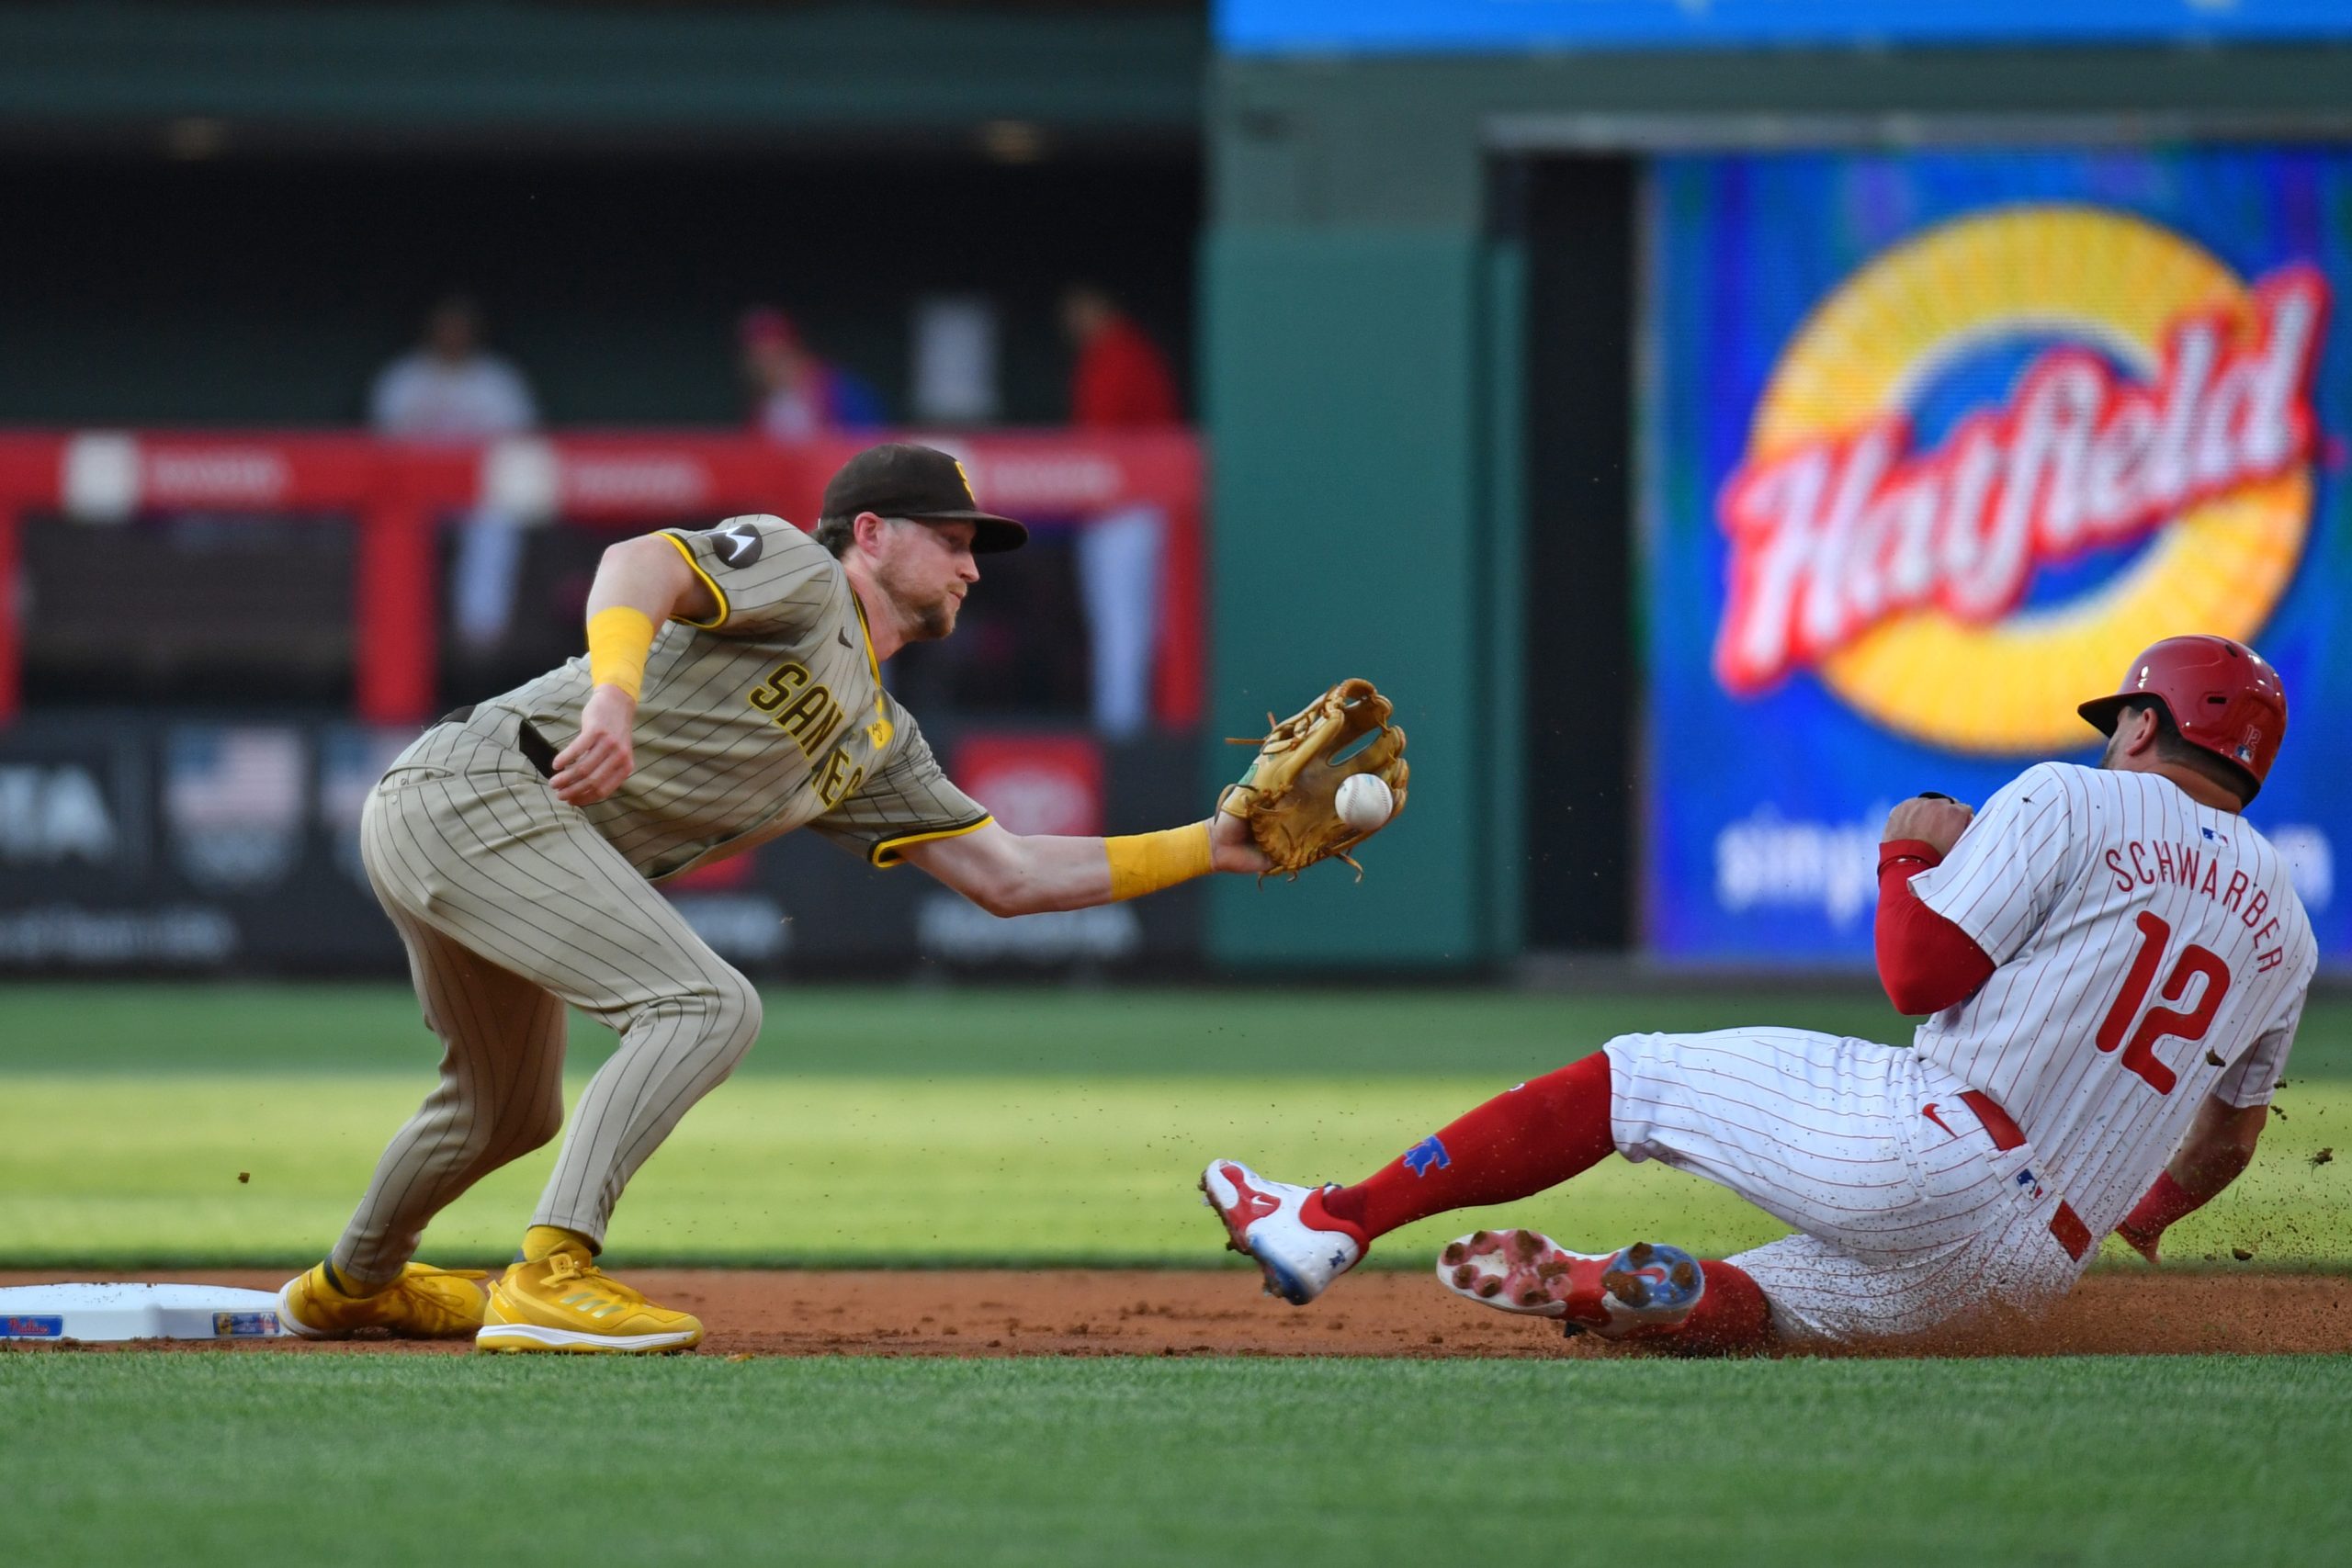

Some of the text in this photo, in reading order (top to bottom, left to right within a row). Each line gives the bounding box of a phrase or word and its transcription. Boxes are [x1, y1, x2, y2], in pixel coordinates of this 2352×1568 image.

[1725, 276, 2323, 684] Hatfield
[749, 661, 844, 761] SAN
[2106, 840, 2284, 974] SCHWARBER
[2095, 909, 2232, 1097] 12
